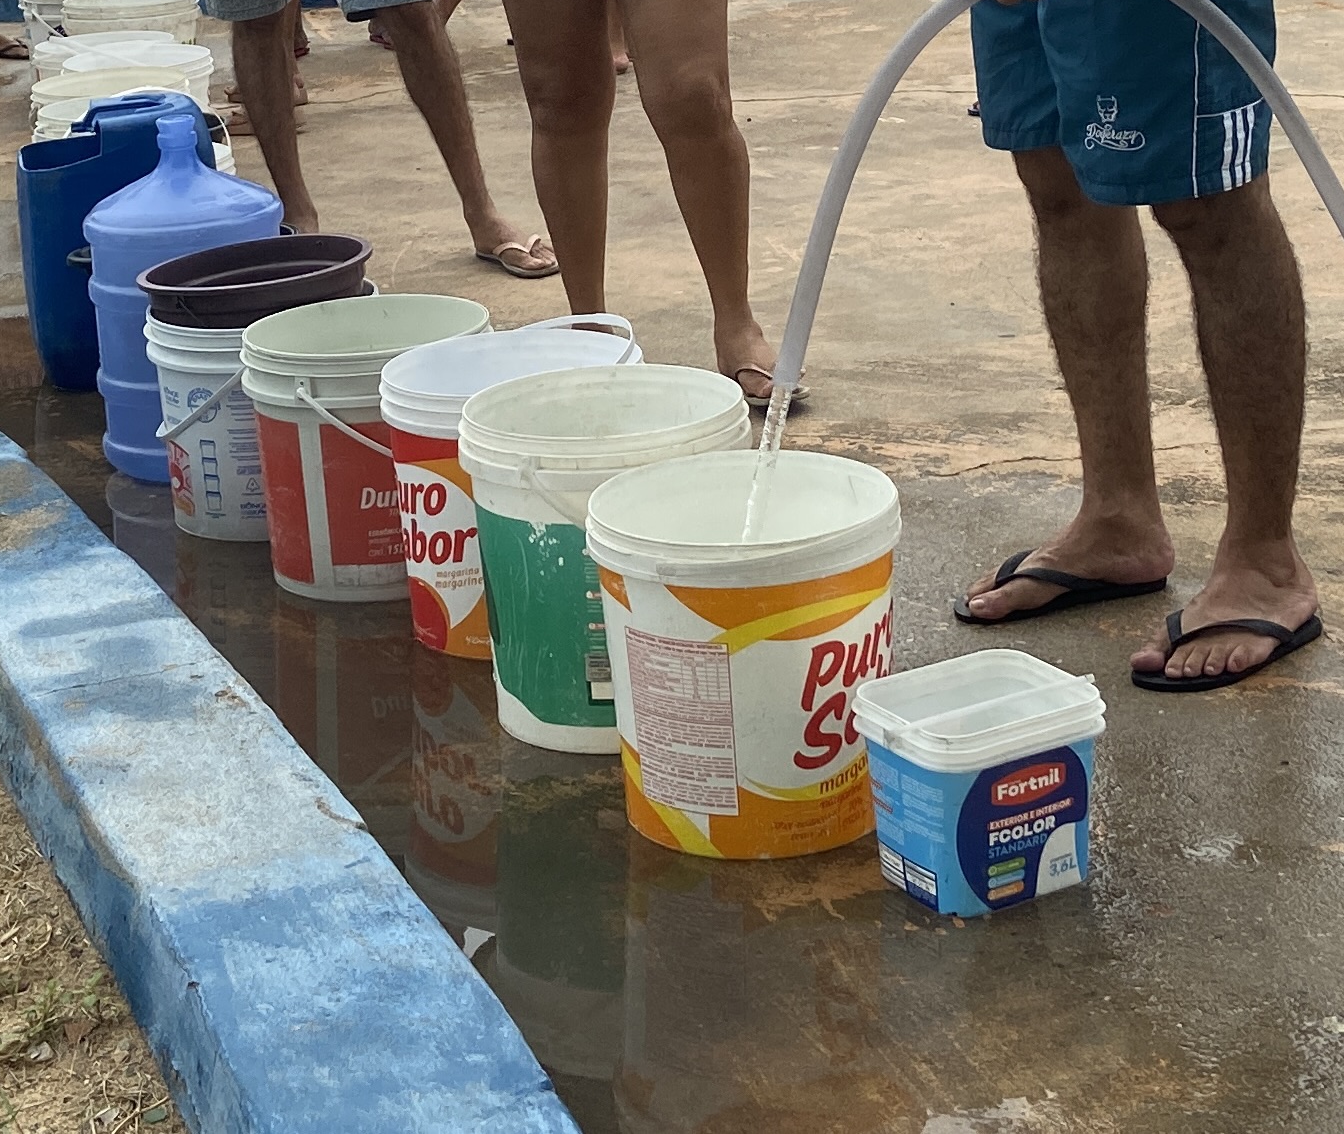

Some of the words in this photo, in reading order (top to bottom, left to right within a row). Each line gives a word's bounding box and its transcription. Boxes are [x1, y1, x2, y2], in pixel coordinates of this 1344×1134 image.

[399, 481, 447, 516] uro
[402, 518, 478, 565] abor
[997, 767, 1060, 801] Fortnil
[989, 813, 1029, 830] EXTERIOR
[1035, 798, 1071, 817] INTERIOR
[988, 833, 1047, 859] STANDARD
[989, 815, 1055, 846] FCOLOR
[1049, 857, 1077, 877] 3,6L
